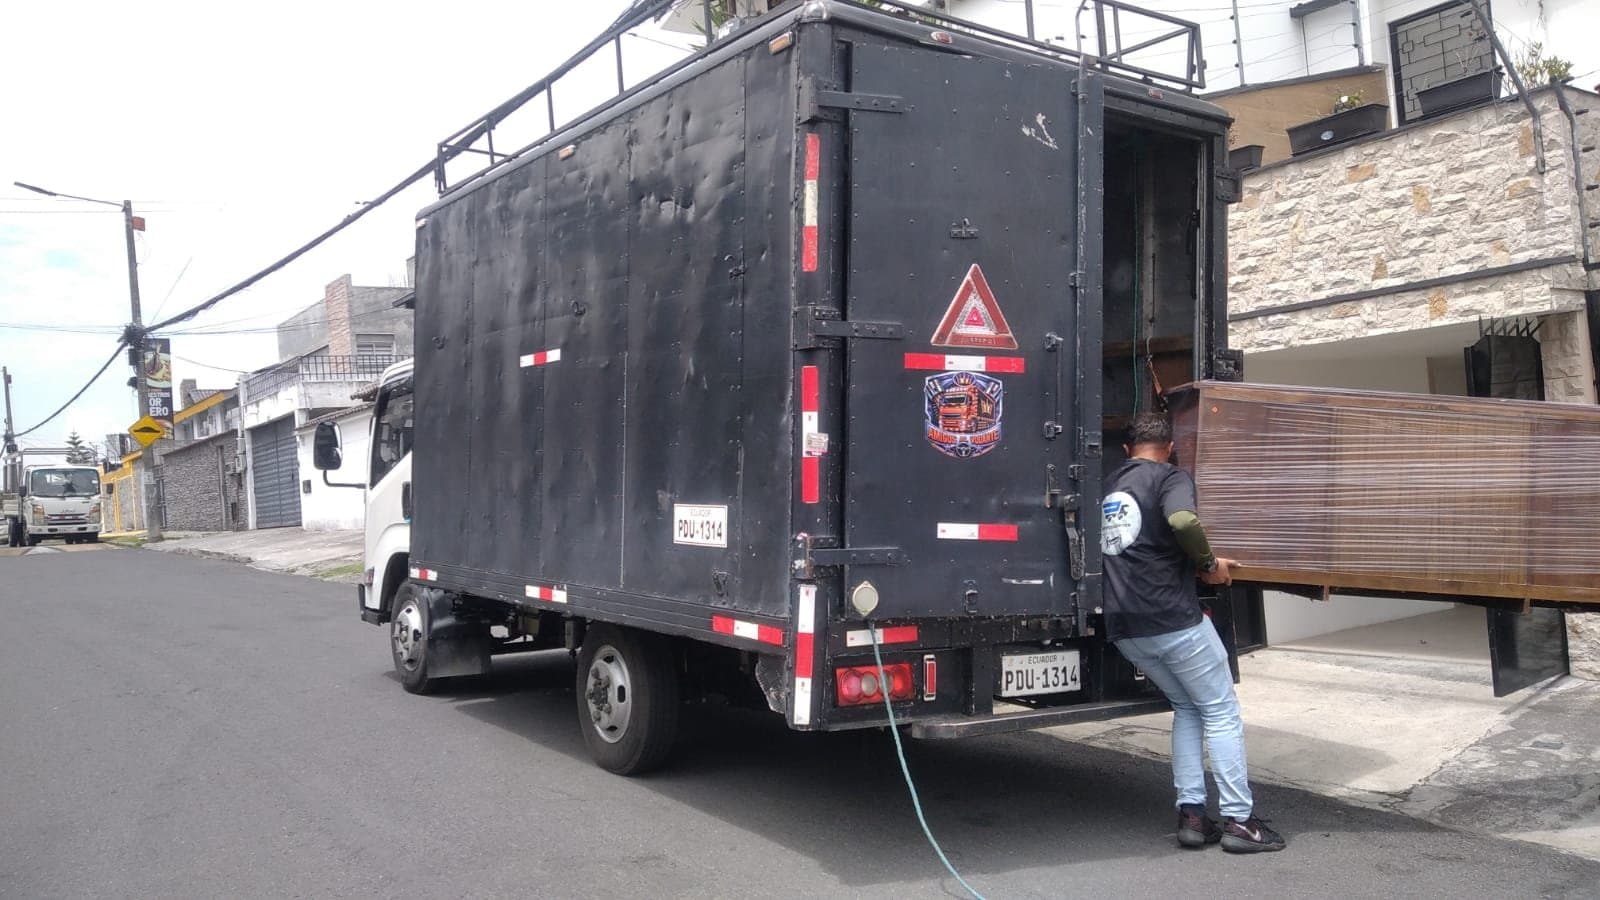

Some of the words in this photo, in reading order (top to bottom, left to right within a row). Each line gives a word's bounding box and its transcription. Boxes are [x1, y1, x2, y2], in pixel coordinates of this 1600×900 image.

[678, 519, 723, 541] PDU-1314
[1027, 654, 1058, 665] ECUADOR
[1005, 665, 1077, 692] PDU-1314
